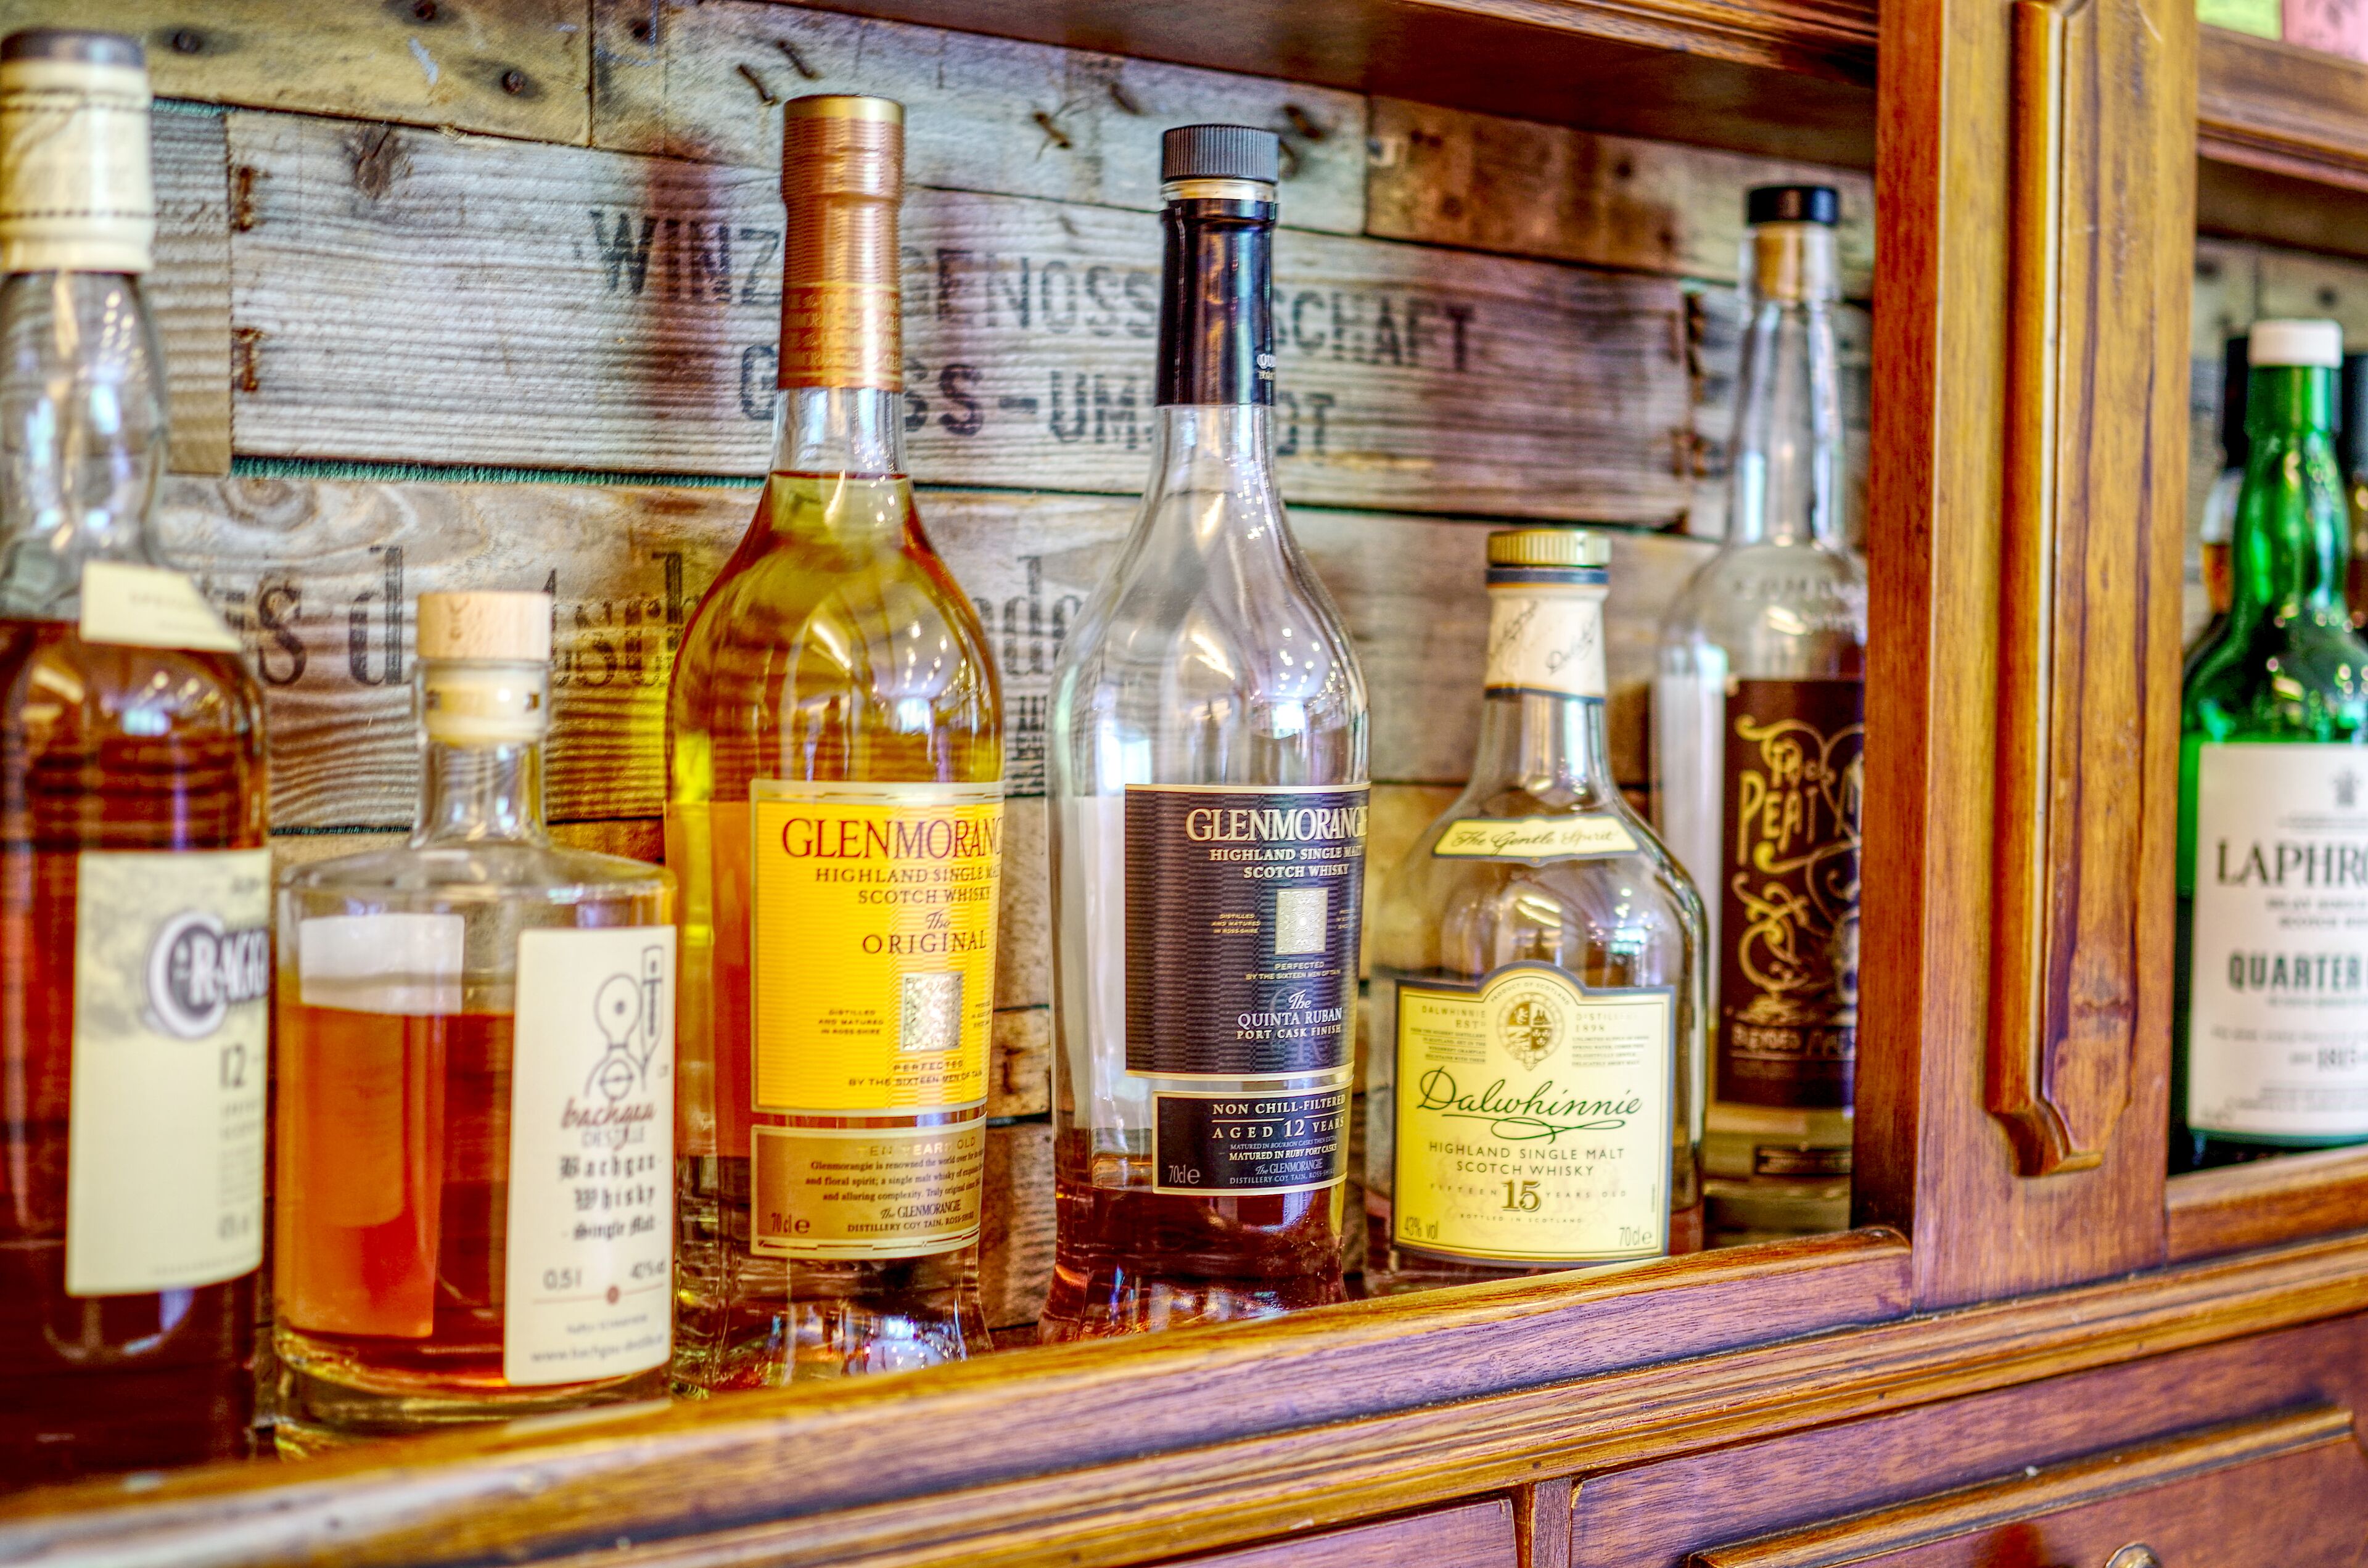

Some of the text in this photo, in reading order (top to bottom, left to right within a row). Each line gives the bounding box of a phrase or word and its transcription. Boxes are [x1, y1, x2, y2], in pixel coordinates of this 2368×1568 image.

[1736, 770, 1819, 866] PEAT
[1451, 830, 1486, 848] The
[1490, 831, 1556, 857] Gentle
[1209, 847, 1296, 861] HIGHLAND
[1300, 847, 1342, 861] SINGLE
[816, 868, 927, 884] HIGHLAND
[933, 866, 983, 882] SINGLE
[1243, 863, 1350, 879] SCOTCH WHISKY
[858, 886, 991, 905] SCOTCH WHISKY
[926, 909, 950, 930] The
[863, 930, 987, 954] ORIGINAL
[1274, 961, 1325, 971] PERFECTED
[2227, 946, 2363, 995] QUARTER
[1276, 972, 1307, 980] SIXTEEN
[1288, 988, 1312, 1009] The
[1490, 983, 1521, 1003] PRODUCT
[1536, 982, 1570, 1006] SCOTLAND
[1236, 1006, 1343, 1030] QUINTA RUBAN
[1421, 1005, 1486, 1019] DALWHINNIE
[1236, 1024, 1342, 1040] PORT CASK FINISH
[1575, 1024, 1605, 1033] 1898
[219, 1042, 247, 1089] 12
[894, 1060, 964, 1072] PERFECTED
[869, 1078, 891, 1086] THE
[895, 1075, 939, 1086] SIXTEEN
[1416, 1065, 1643, 1117] Dalwhinnie
[1212, 1093, 1347, 1115] NON CHILL-FILTERED
[1212, 1115, 1344, 1139] AGED 12 YEARS
[956, 1136, 976, 1150] OLD
[1429, 1142, 1624, 1160] HIGHLAND SINGLE MALT
[1229, 1143, 1338, 1162] MATURED IN RUBY PORT CASKS
[810, 1160, 873, 1172] Glenmorangie
[1255, 1158, 1323, 1175] The GLENMORANGIE
[1457, 1161, 1594, 1176] SCOTCH WHISKY
[805, 1176, 822, 1184] and
[824, 1176, 849, 1185] floral
[1229, 1176, 1273, 1184] DISTILLERY
[823, 1192, 839, 1201] and
[841, 1192, 876, 1202] alluring
[1430, 1183, 1497, 1196] FIFTEEN
[1500, 1179, 1541, 1213] 15
[897, 1199, 962, 1219] GLENMORANGIE
[1460, 1213, 1503, 1221] BOTTLED
[847, 1222, 900, 1232] DISTILLERY
[1404, 1215, 1438, 1240] 43% vol
